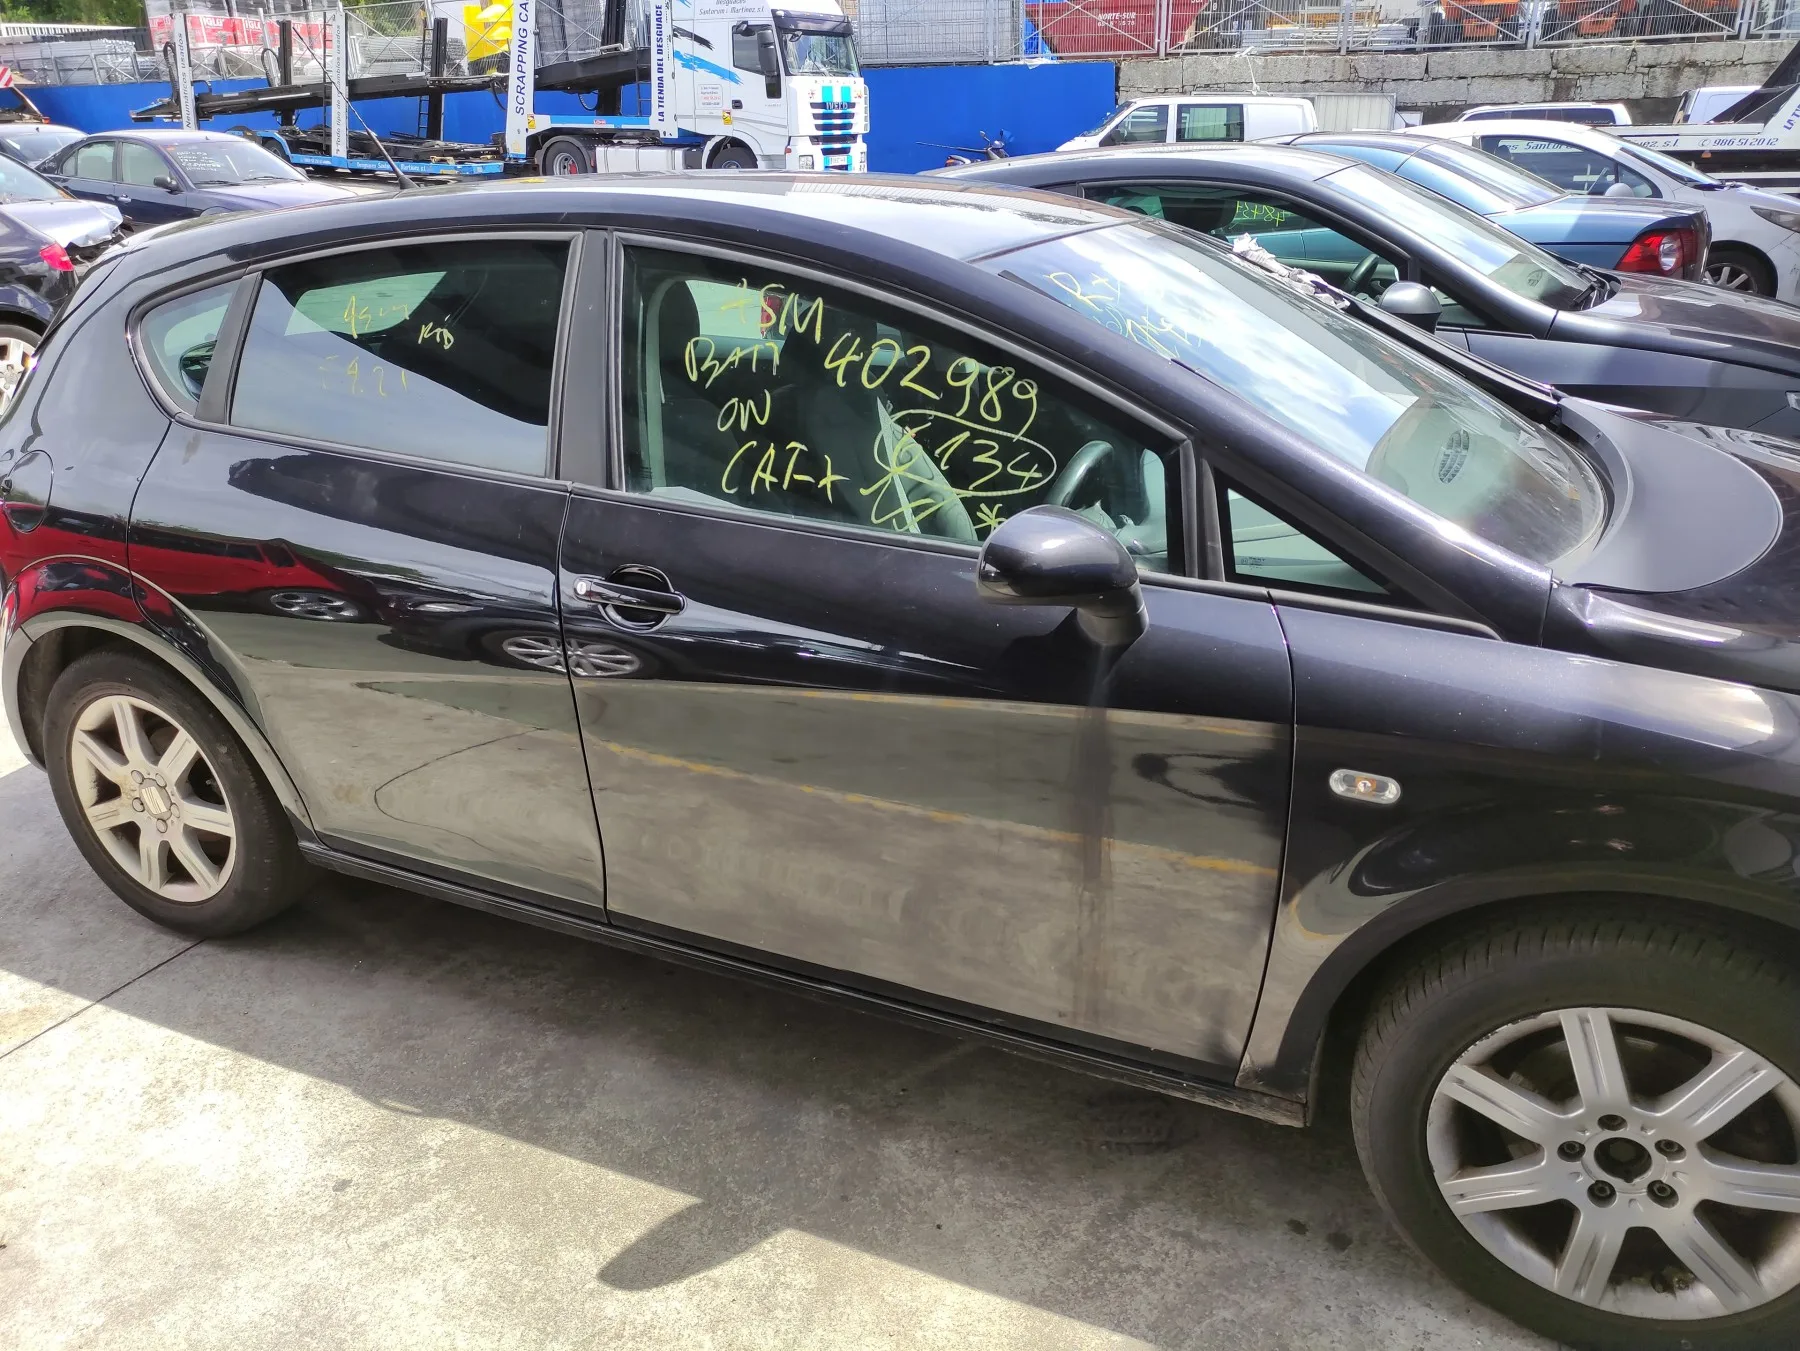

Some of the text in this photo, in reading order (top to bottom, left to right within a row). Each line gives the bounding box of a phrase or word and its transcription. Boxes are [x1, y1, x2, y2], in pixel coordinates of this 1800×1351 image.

[177, 32, 186, 69] usados
[515, 0, 529, 116] SCRAPPING CA
[655, 4, 665, 122] LA TIENDA DEL DESGUACE
[1713, 138, 1735, 147] 986
[717, 389, 771, 433] ON
[824, 333, 1038, 442] 402989
